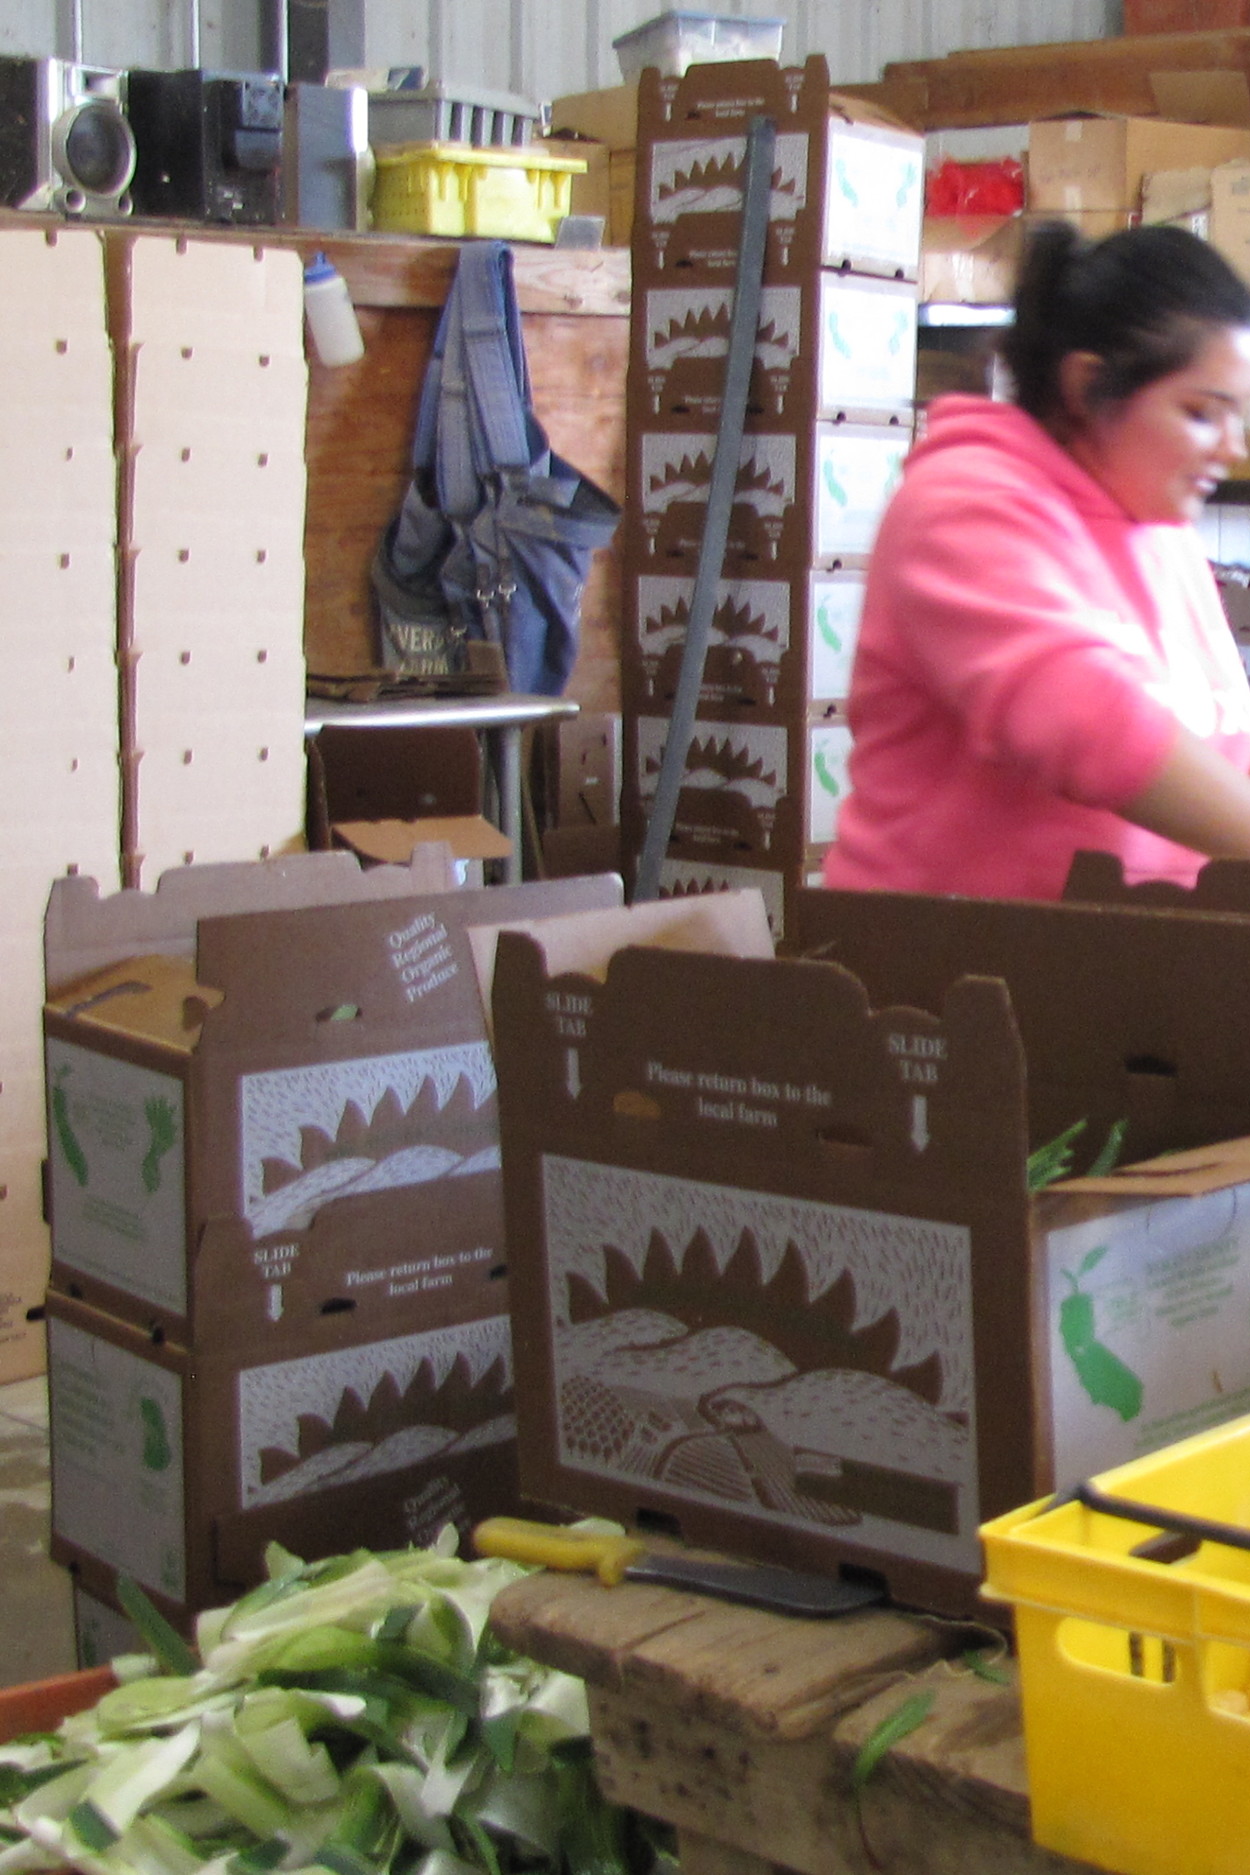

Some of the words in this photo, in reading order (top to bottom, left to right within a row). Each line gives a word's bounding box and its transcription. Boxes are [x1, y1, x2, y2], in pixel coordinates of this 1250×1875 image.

[389, 911, 436, 949] Quality
[393, 923, 448, 969] Regional
[402, 945, 453, 984] Organic
[406, 963, 459, 1003] Produce
[544, 991, 593, 1016] SLIDE
[556, 1015, 587, 1036] TAB
[888, 1033, 949, 1060] SLIDE
[648, 1061, 692, 1087] Please
[697, 1073, 748, 1094] return
[751, 1076, 780, 1099] box
[785, 1083, 801, 1102] to
[806, 1084, 832, 1106] the
[899, 1060, 939, 1082] TAB
[698, 1096, 734, 1120] local
[738, 1102, 778, 1127] farm
[253, 1243, 300, 1265] SLIDE
[346, 1269, 387, 1287] Please
[389, 1259, 431, 1277] return
[433, 1254, 455, 1270] box
[459, 1251, 472, 1264] to
[474, 1247, 494, 1260] the
[263, 1262, 292, 1279] TAB
[388, 1279, 420, 1296] local
[421, 1273, 453, 1290] farm
